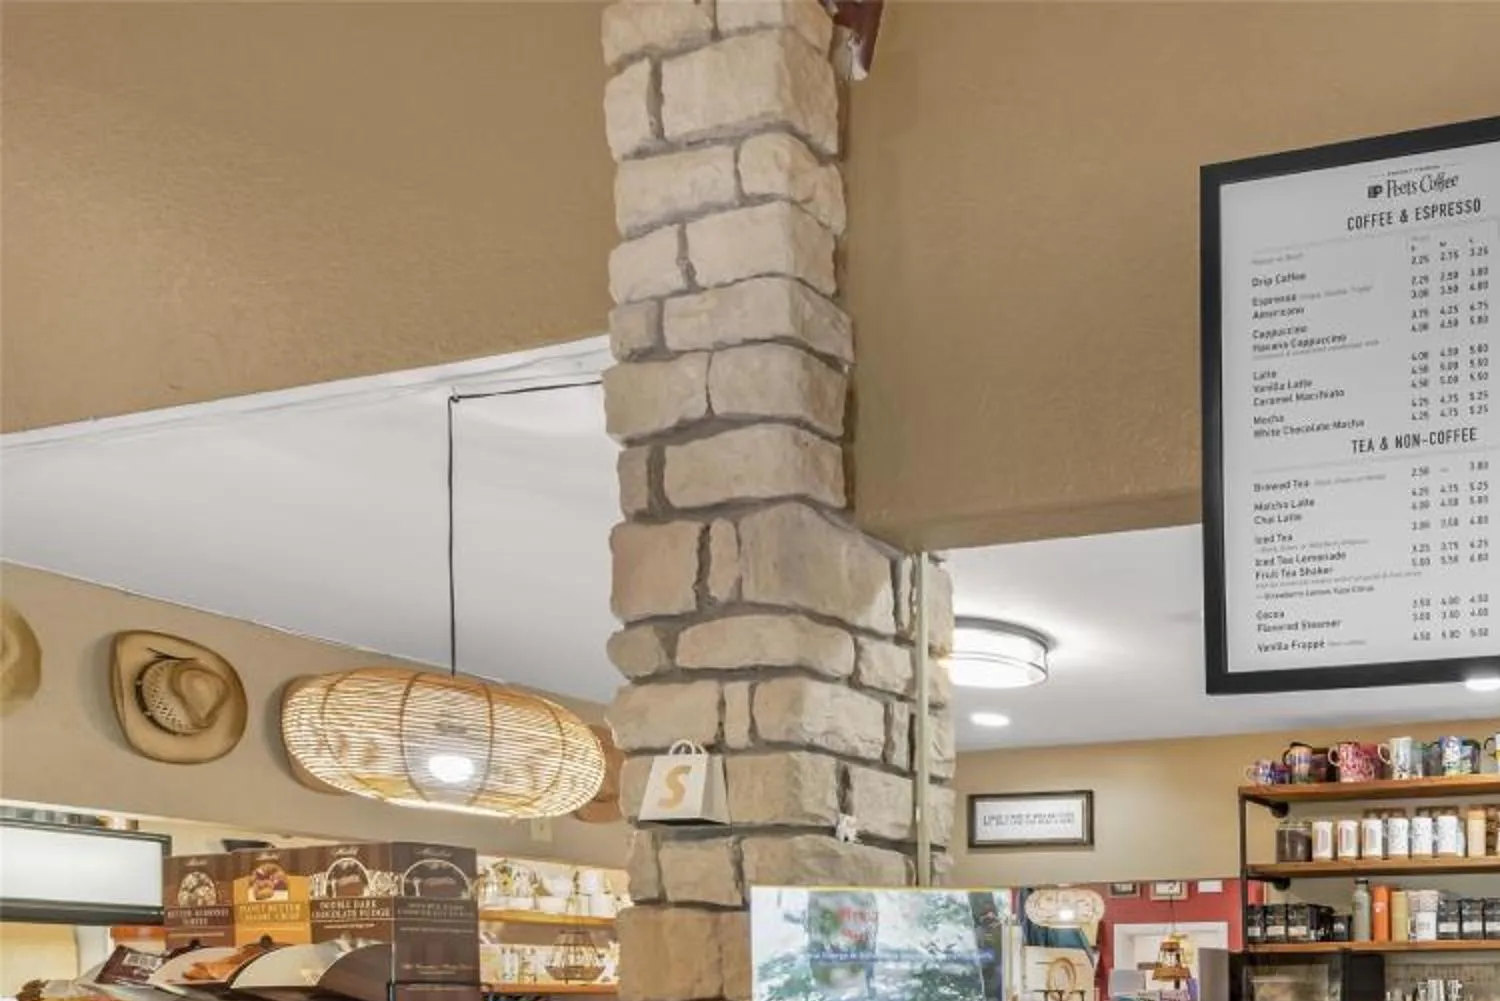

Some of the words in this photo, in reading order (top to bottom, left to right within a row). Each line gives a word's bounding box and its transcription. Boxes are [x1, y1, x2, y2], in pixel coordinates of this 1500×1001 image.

[1419, 172, 1459, 193] Coffee
[1347, 211, 1393, 231] COFFEE
[1399, 208, 1409, 224] &
[1415, 197, 1481, 221] ESPRESSO
[1252, 276, 1273, 287] Drip
[1275, 272, 1306, 284] Coffee
[1290, 334, 1347, 348] Cappuccino
[1351, 438, 1376, 455] TEA
[1379, 436, 1390, 451] &
[1394, 427, 1478, 449] NON-COFFEE
[1293, 480, 1310, 489] Tea
